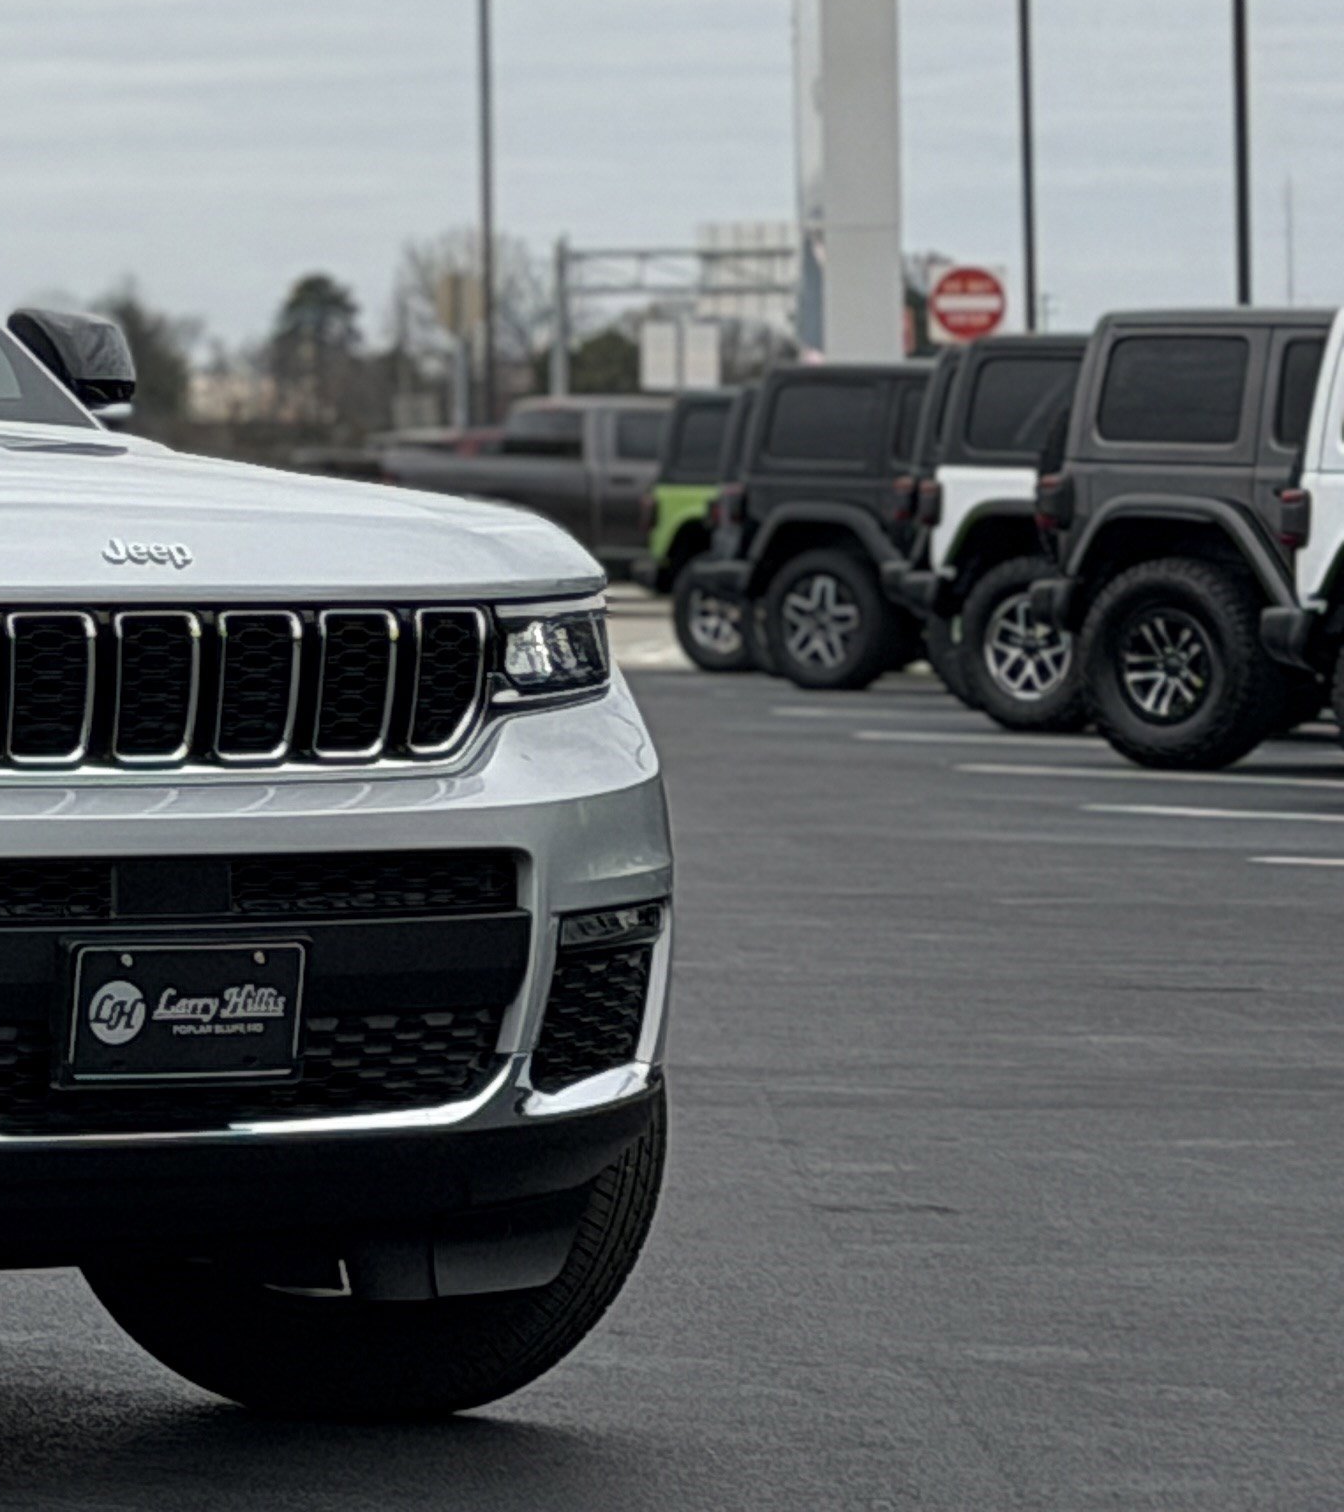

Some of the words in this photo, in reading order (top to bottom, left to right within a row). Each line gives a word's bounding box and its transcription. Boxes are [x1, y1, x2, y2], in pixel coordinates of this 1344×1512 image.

[102, 537, 192, 570] Jeep
[152, 988, 219, 1022] Larry
[220, 984, 286, 1018] Hillis
